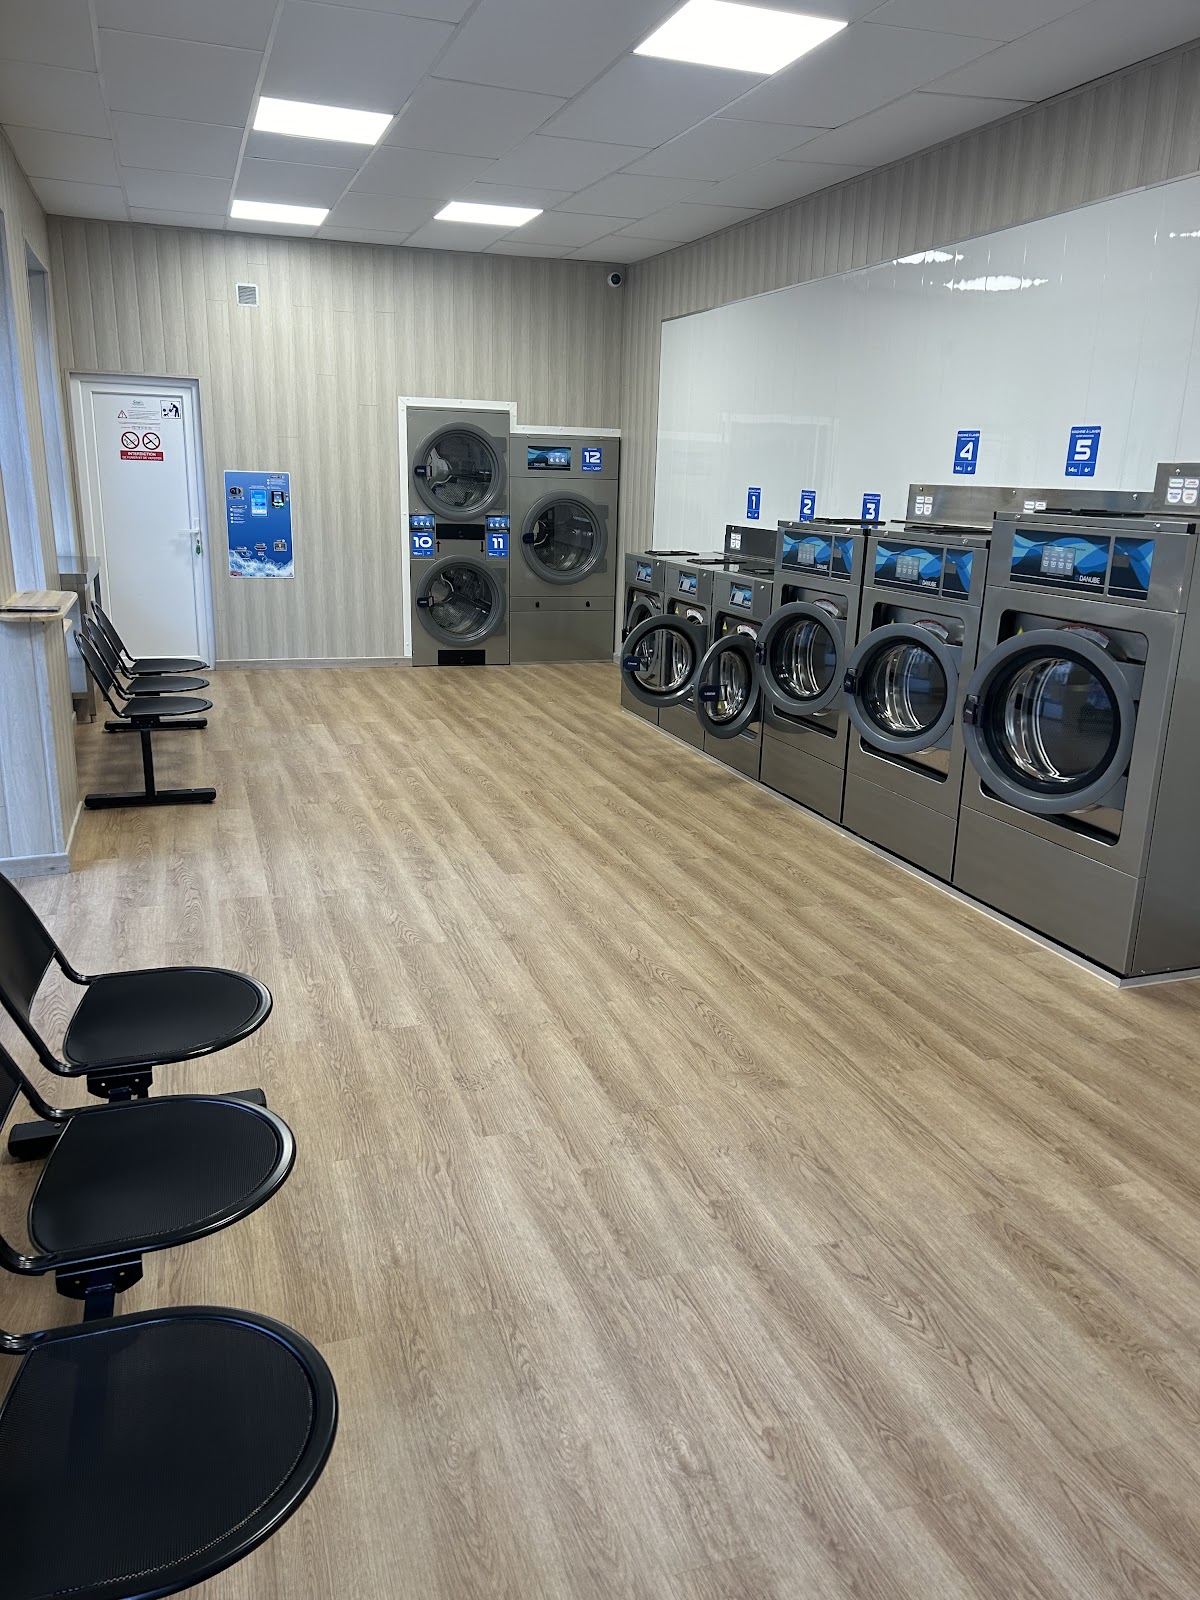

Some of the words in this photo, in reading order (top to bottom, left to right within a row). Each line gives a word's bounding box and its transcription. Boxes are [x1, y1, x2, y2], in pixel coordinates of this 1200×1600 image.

[960, 441, 973, 460] 4
[1074, 439, 1092, 460] 5
[584, 451, 601, 463] 12
[752, 495, 756, 509] 1
[803, 499, 812, 514] 2
[866, 503, 876, 519] 3
[413, 536, 432, 548] 10
[492, 537, 503, 549] 11
[921, 579, 937, 588] DANUBE
[1079, 574, 1101, 584] DANUBE
